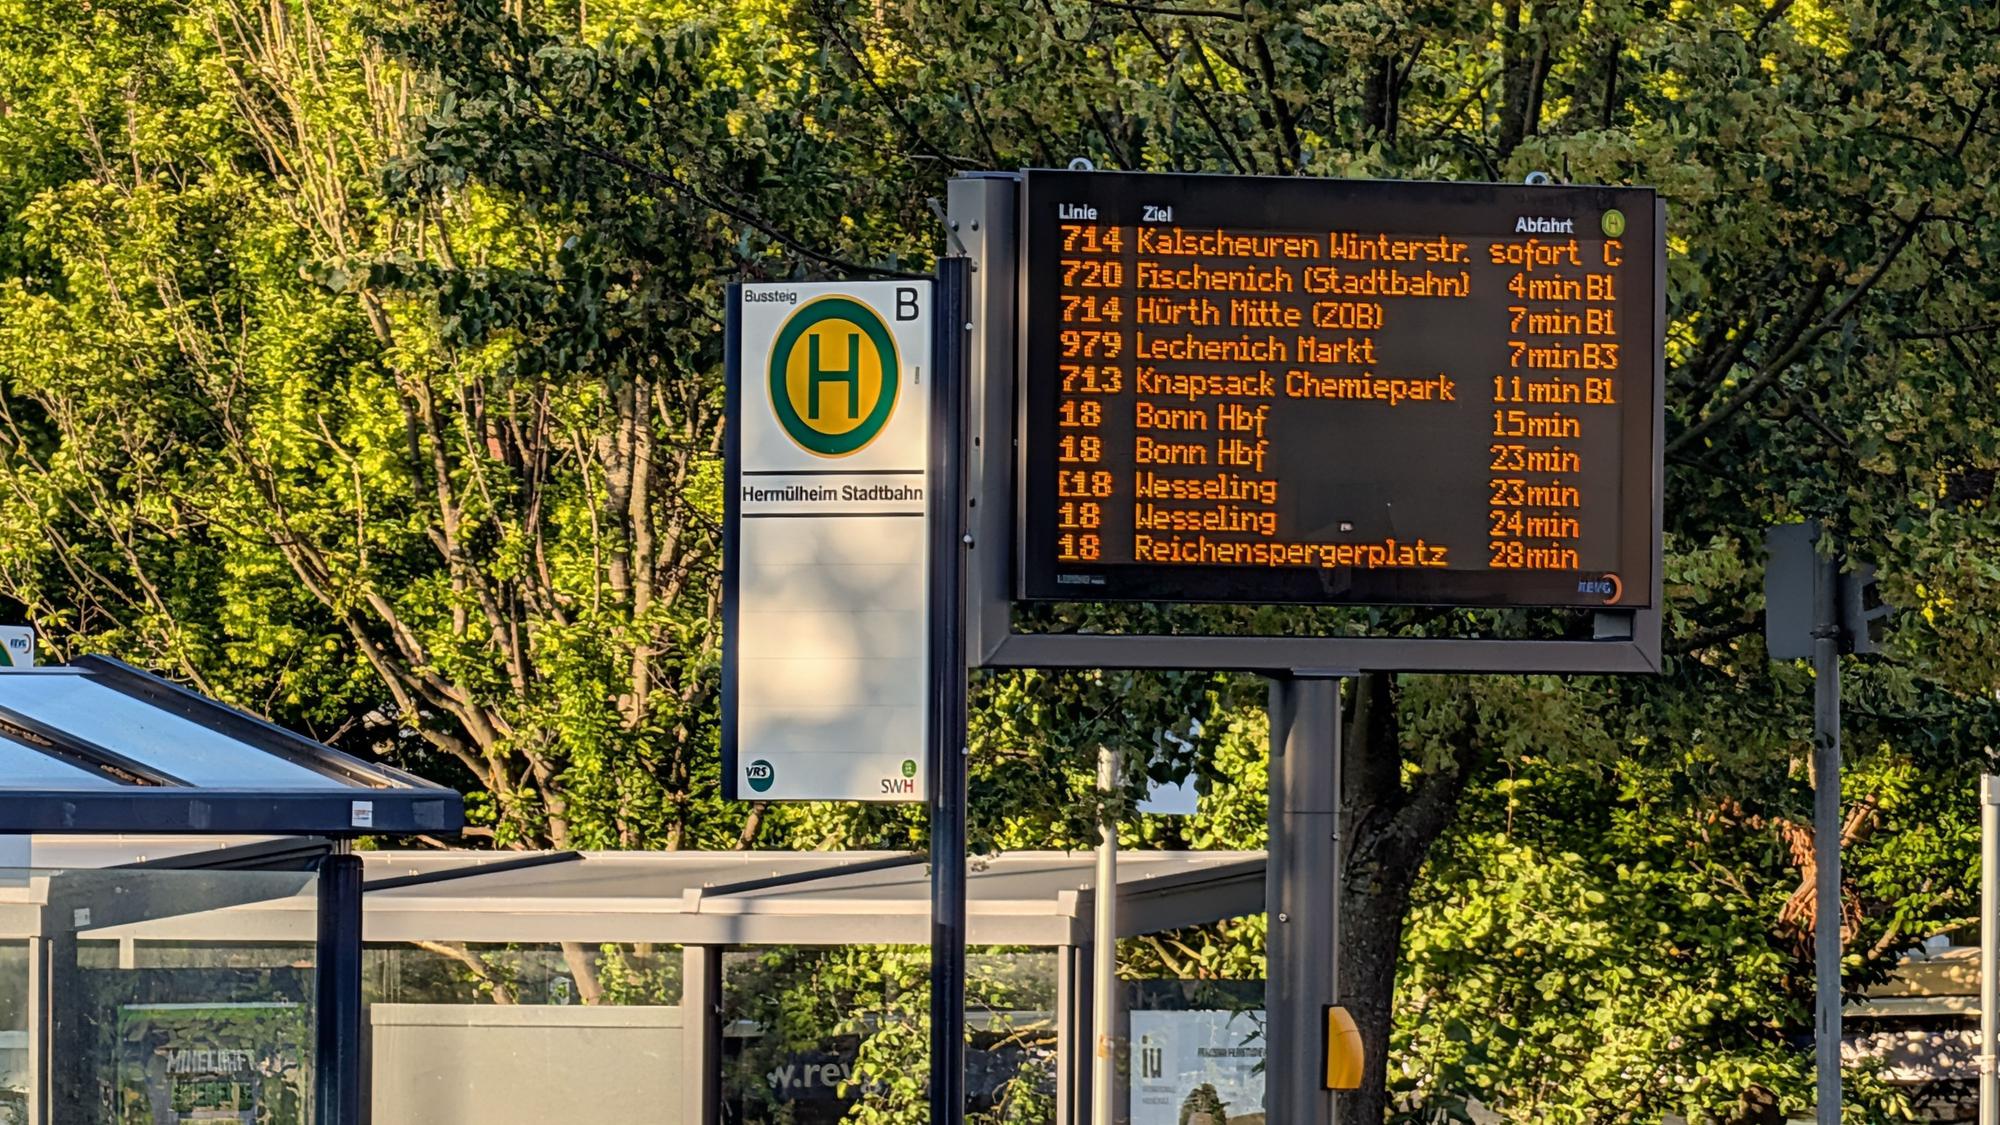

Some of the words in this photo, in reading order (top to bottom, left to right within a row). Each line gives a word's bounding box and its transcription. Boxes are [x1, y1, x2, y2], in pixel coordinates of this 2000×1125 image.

[1059, 204, 1097, 219] Linie
[1143, 206, 1172, 221] Ziel
[1516, 217, 1573, 233] Abfahrt
[1062, 225, 1123, 252] 714
[1138, 227, 1319, 257] Kalscheuren
[1331, 233, 1469, 262] Winterstr.
[1489, 239, 1581, 271] sofort
[1604, 240, 1621, 266] C
[745, 290, 797, 303] Bussteig
[1061, 261, 1122, 287] 720
[1138, 263, 1292, 292] Fischenich
[1305, 267, 1469, 296] (Stadtbahn)
[1509, 273, 1581, 300] 4min
[1587, 275, 1616, 300] B1
[896, 287, 919, 321] B
[1061, 296, 1122, 322] 714
[1137, 298, 1219, 325] Hürth
[1231, 300, 1301, 327] Mitte
[1313, 302, 1382, 329] (ZOB)
[1509, 307, 1581, 334] 7min
[1587, 309, 1615, 335] B1
[1061, 331, 1121, 357] 979
[1137, 332, 1286, 361] Lechenich
[1298, 336, 1376, 363] Markt
[1508, 341, 1580, 368] 7min
[1583, 343, 1619, 369] B3
[808, 334, 859, 419] H
[1060, 365, 1122, 392] 713
[1136, 366, 1276, 402] Knapsack
[1287, 371, 1455, 405] Chemiepark
[1495, 376, 1580, 403] 11min
[1586, 378, 1615, 403] B1
[1060, 401, 1100, 426] 18
[1137, 400, 1207, 430] Bonn
[1219, 404, 1269, 437] Hbf
[1494, 410, 1580, 437] 15min
[1060, 436, 1100, 462] 18
[1136, 437, 1207, 464] Bonn
[1218, 439, 1268, 472] Hbf
[1490, 445, 1580, 472] 23min
[742, 487, 837, 501] Hermülheim
[842, 484, 923, 500] Stadtbahn
[1059, 471, 1112, 497] E18
[1136, 471, 1278, 504] Wesseling
[1490, 479, 1579, 507] 23min
[1059, 503, 1100, 528] 18
[1136, 503, 1277, 535] Wesseling
[1490, 510, 1579, 537] 24min
[1059, 534, 1099, 559] 18
[1135, 534, 1449, 568] Reichenspergerplatz
[1490, 541, 1578, 569] 28min
[746, 767, 767, 777] VRS
[881, 779, 914, 793] SWH
